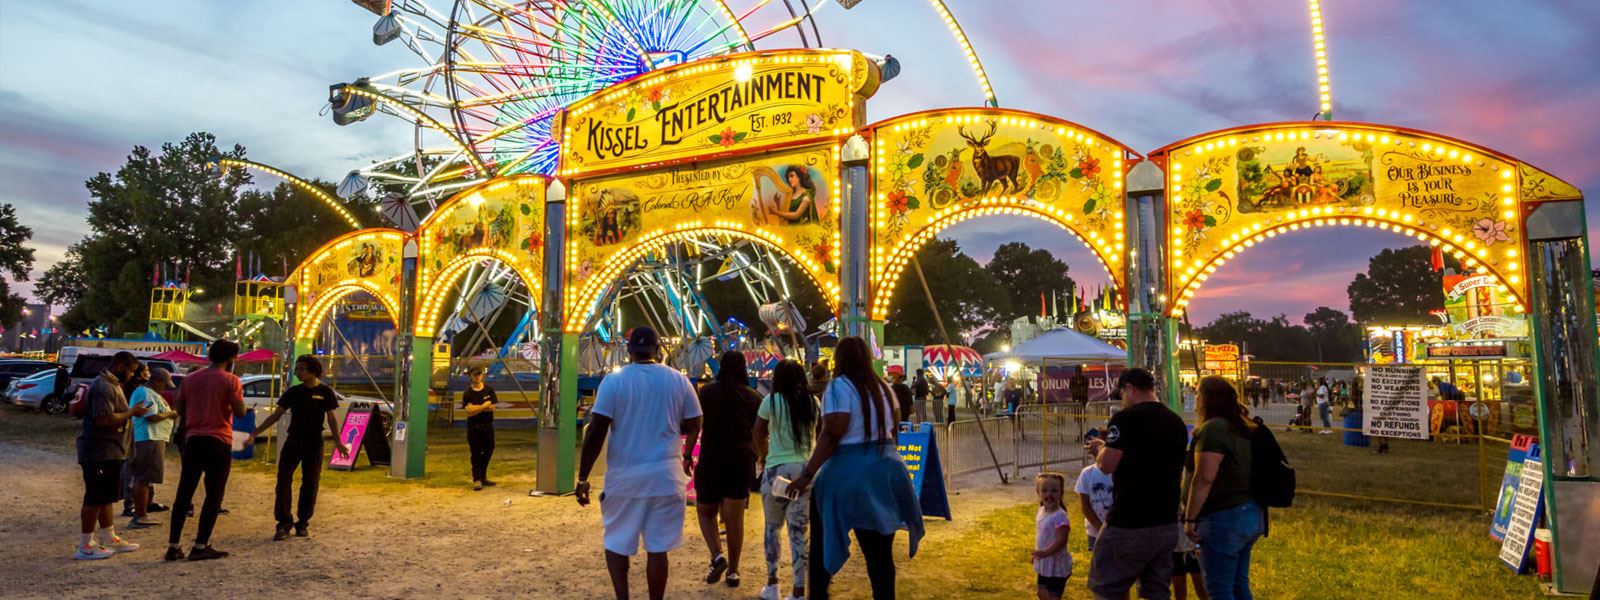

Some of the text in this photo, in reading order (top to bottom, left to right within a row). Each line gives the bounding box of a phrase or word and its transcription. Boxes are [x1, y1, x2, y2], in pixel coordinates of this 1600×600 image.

[588, 72, 825, 160] KISSEL ENTERTAINMENT
[772, 111, 792, 127] 1932
[1387, 163, 1472, 181] OUR BUSINESS
[1407, 178, 1454, 193] IS YOUR
[1398, 192, 1463, 208] PLEASURE
[1041, 378, 1070, 390] ONLIN
[1384, 421, 1420, 430] REFUNDS
[1381, 430, 1421, 438] EXCEPTIONS
[908, 444, 922, 452] Not
